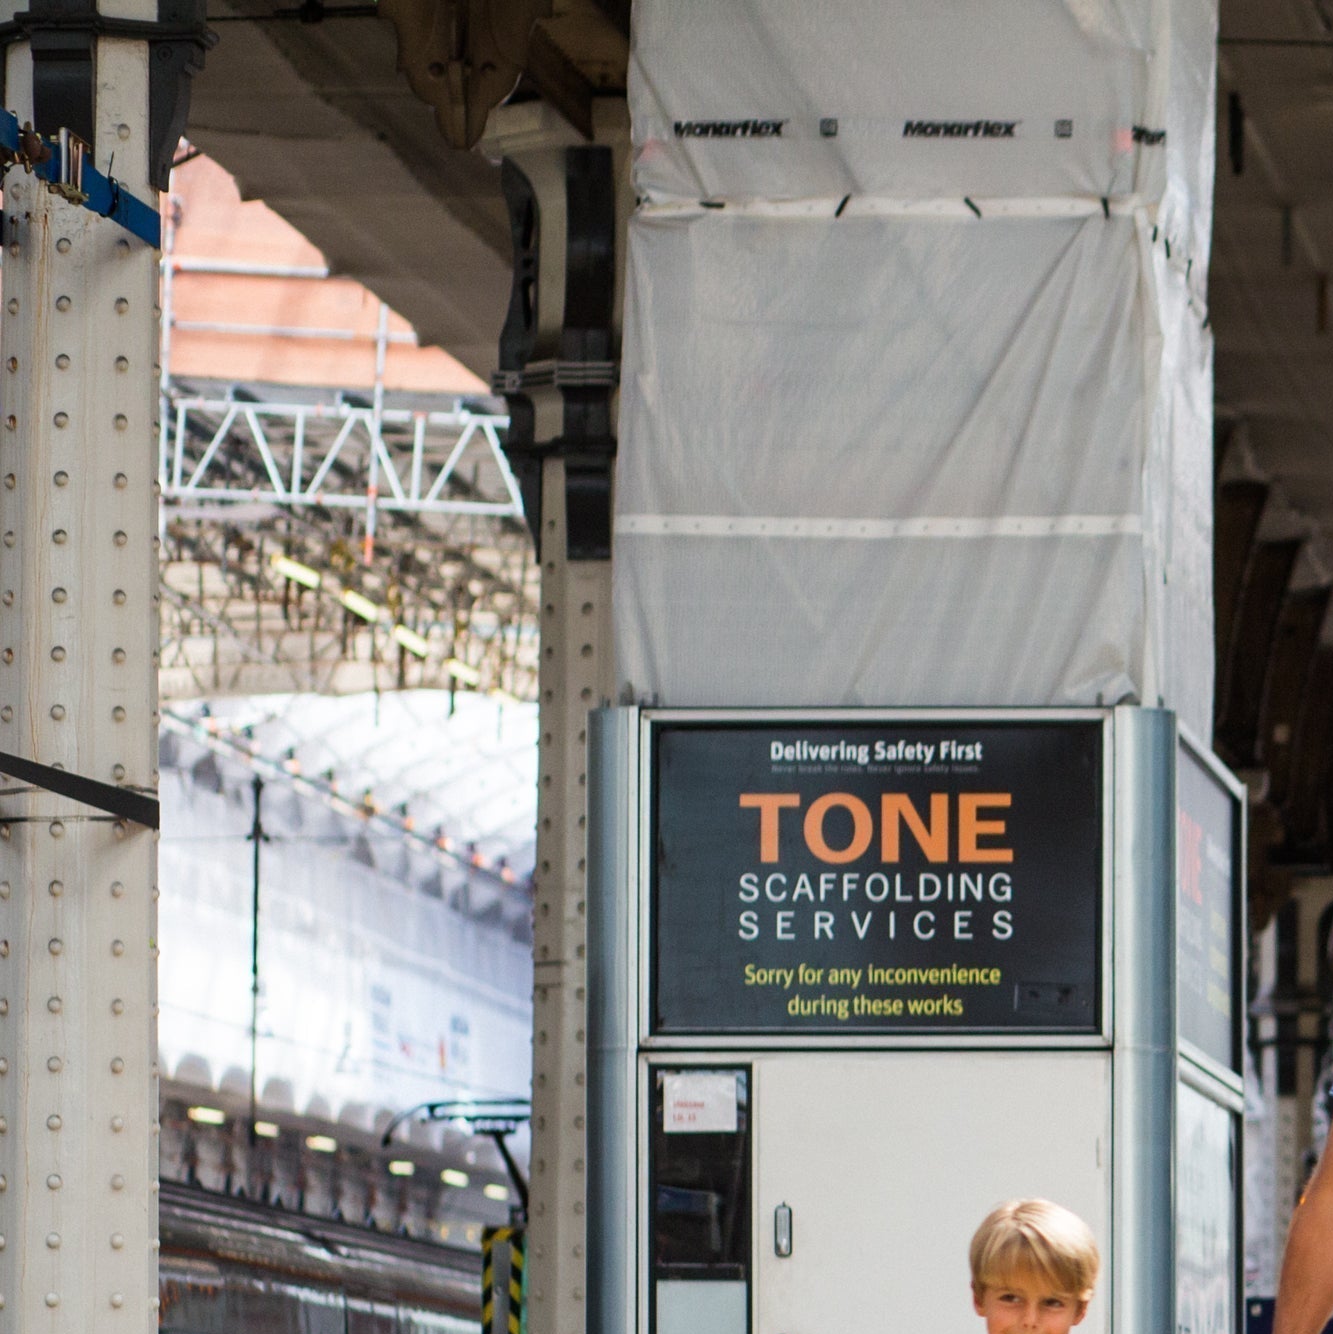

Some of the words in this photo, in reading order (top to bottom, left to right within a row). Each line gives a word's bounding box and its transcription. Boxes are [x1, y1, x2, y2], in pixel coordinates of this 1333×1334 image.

[673, 119, 784, 138] Monarflex
[903, 119, 1017, 138] Monarflex
[770, 740, 870, 765] Delivering
[874, 740, 935, 764] Safety
[940, 740, 983, 761] First
[739, 792, 1014, 864] TONE
[739, 872, 1013, 902] SCAFFOLDING
[738, 910, 1014, 941] SERVICES
[744, 964, 794, 989] Sorry
[798, 963, 823, 985] for
[828, 968, 862, 989] any
[868, 964, 1001, 985] inconvenience
[787, 994, 849, 1020] during
[853, 994, 903, 1015] these
[907, 995, 964, 1015] works
